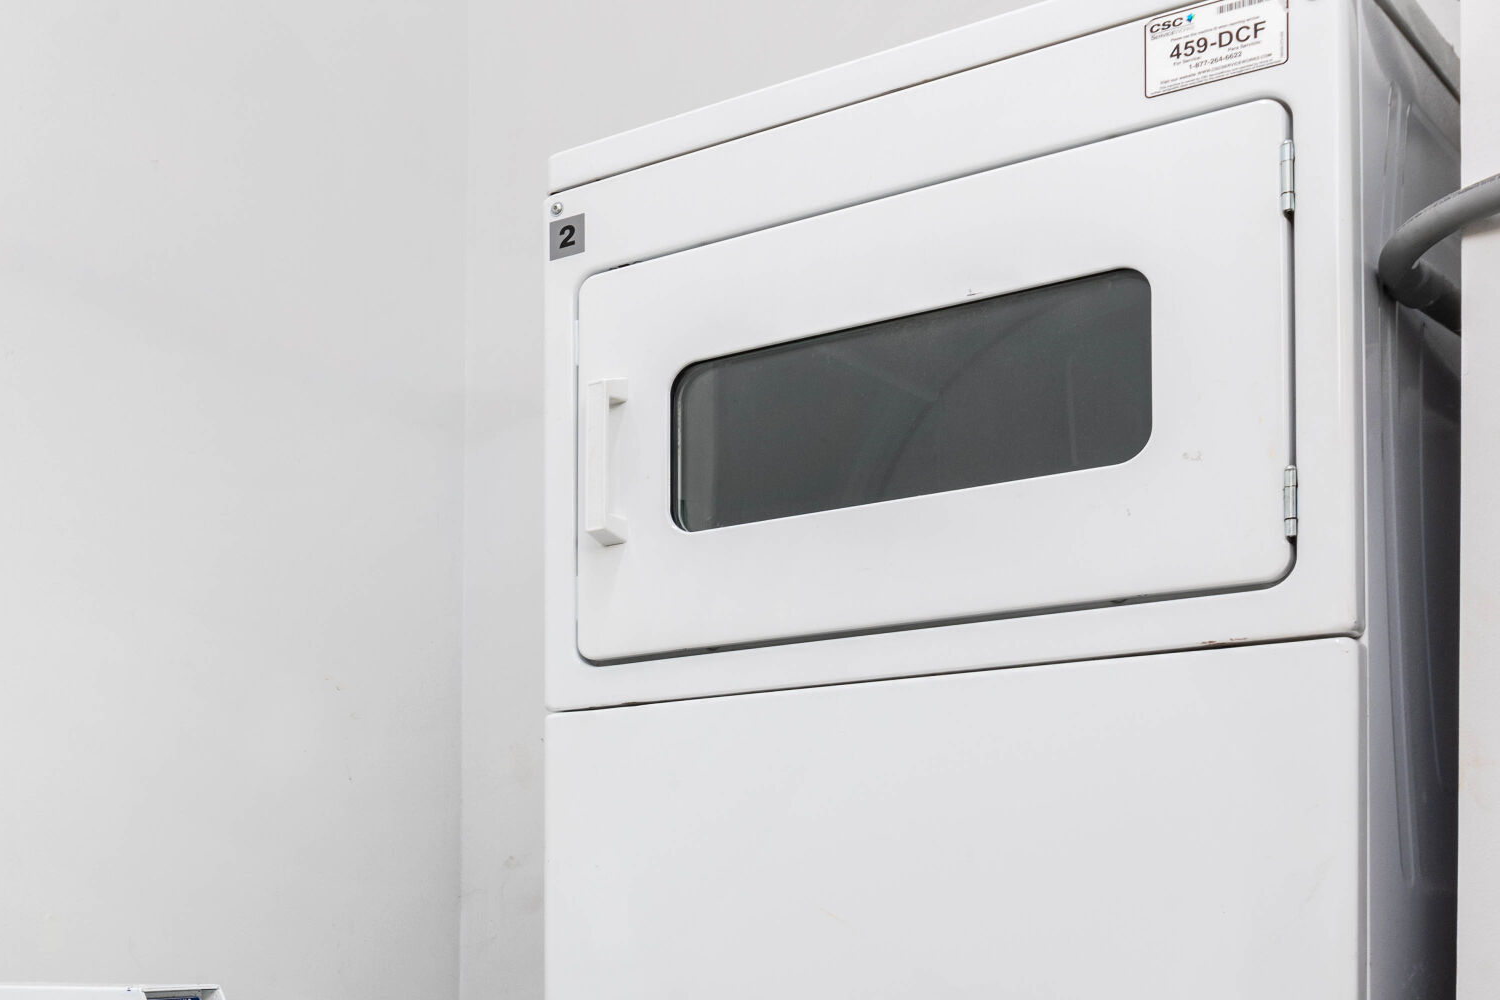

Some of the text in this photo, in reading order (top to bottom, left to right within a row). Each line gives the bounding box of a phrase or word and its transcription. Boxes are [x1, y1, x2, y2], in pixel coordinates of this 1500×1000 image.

[1149, 17, 1184, 34] CSC
[1169, 20, 1266, 60] 459-DCF
[559, 224, 576, 249] 2
